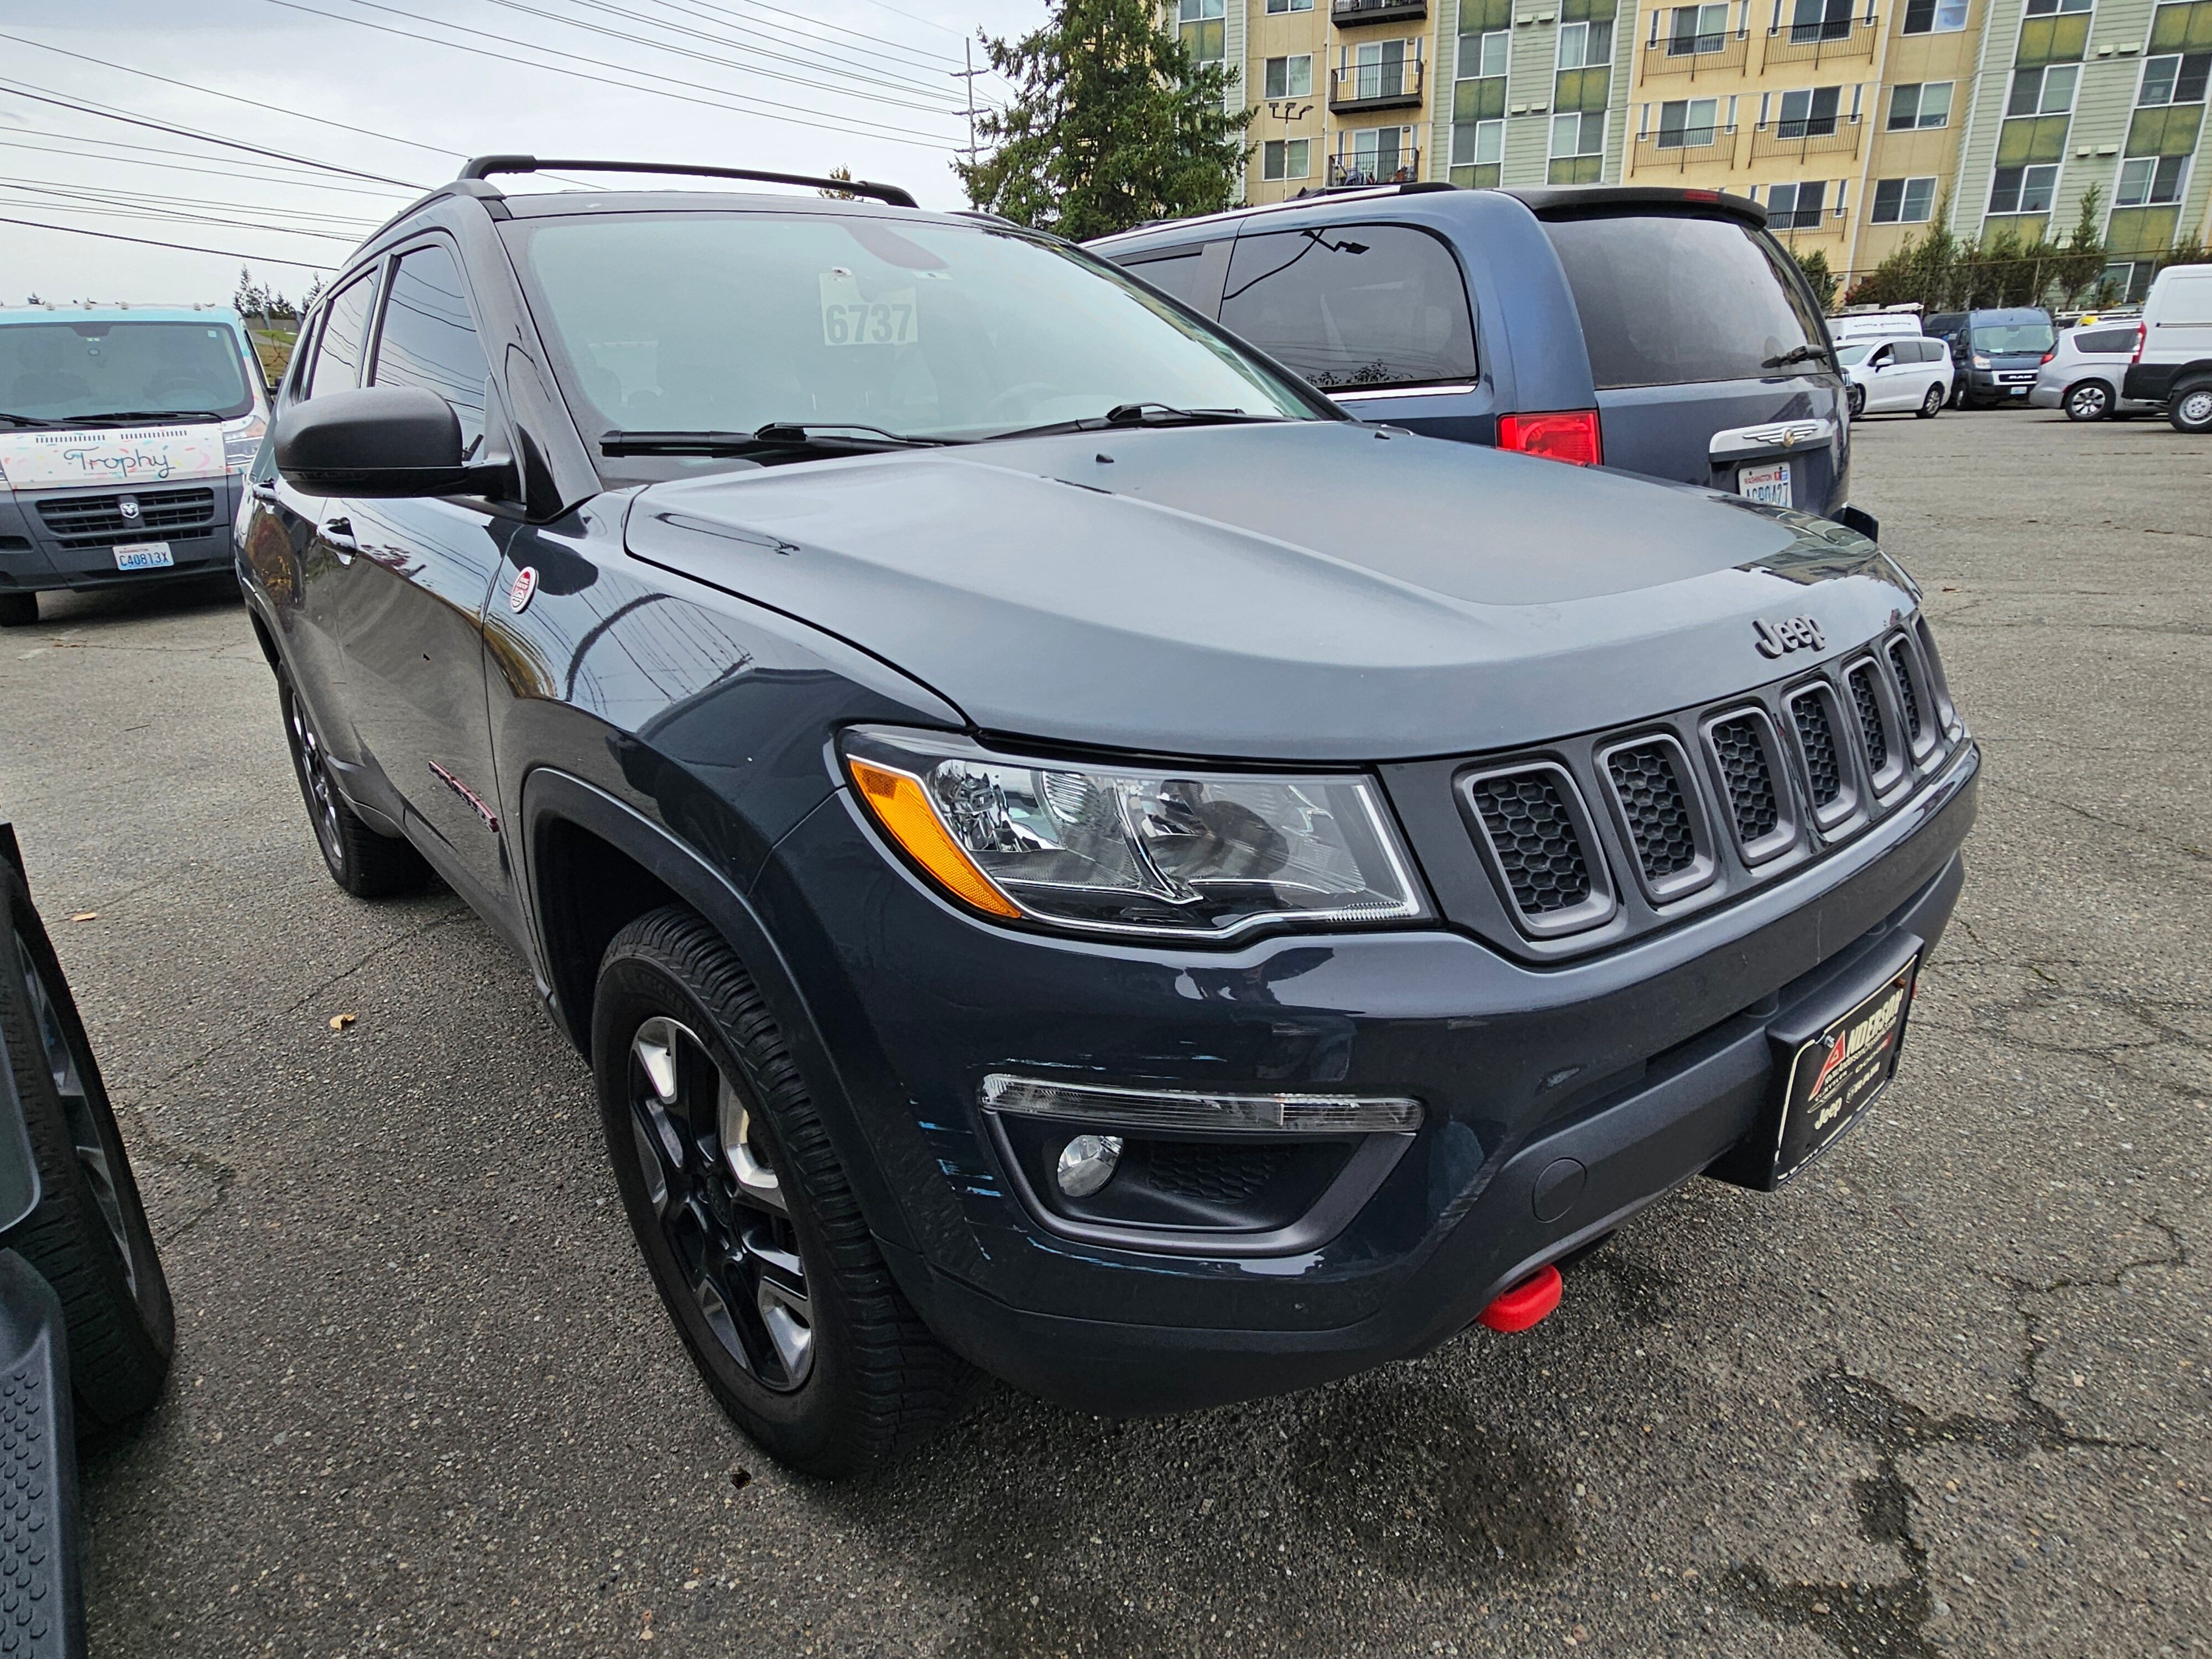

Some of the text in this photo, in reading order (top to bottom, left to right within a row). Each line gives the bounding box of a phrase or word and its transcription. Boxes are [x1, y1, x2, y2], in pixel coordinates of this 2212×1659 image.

[826, 304, 912, 344] 6737
[64, 446, 176, 478] Trophy
[119, 551, 169, 566] C40813X
[1752, 614, 1825, 659] Jeep
[1807, 988, 1904, 1102] ANDERSON
[1854, 1061, 1881, 1094] RAM
[1814, 1097, 1843, 1130] Jeep
